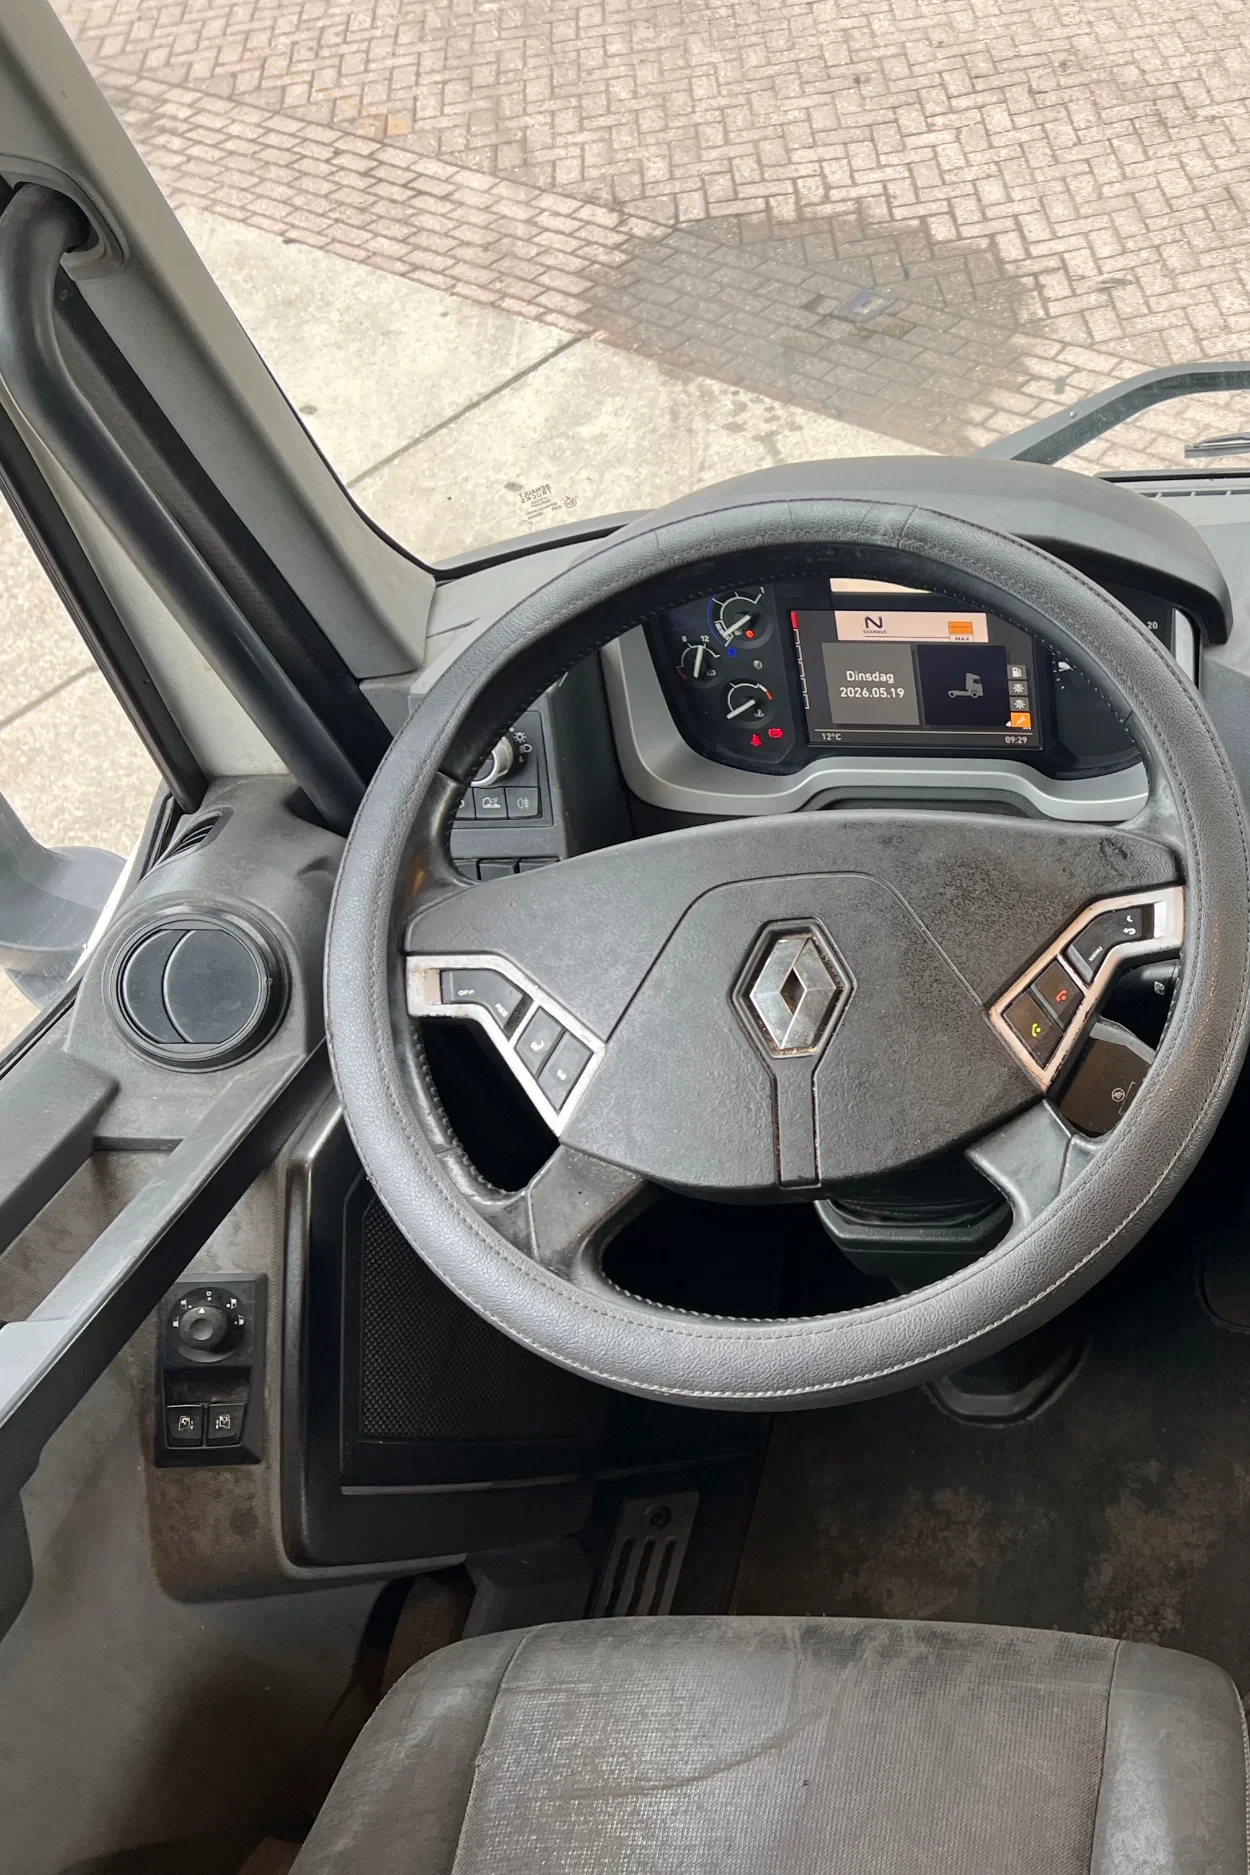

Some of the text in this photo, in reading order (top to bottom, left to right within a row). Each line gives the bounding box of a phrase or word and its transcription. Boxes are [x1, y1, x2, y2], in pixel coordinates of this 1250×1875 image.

[864, 616, 883, 629] N
[700, 635, 710, 643] 12
[846, 670, 895, 684] Dinsdag
[839, 687, 905, 699] 2026.05.19
[821, 732, 842, 742] 12°C
[1005, 735, 1029, 745] 09:29
[1088, 945, 1104, 962] MENU
[458, 989, 475, 997] OFF
